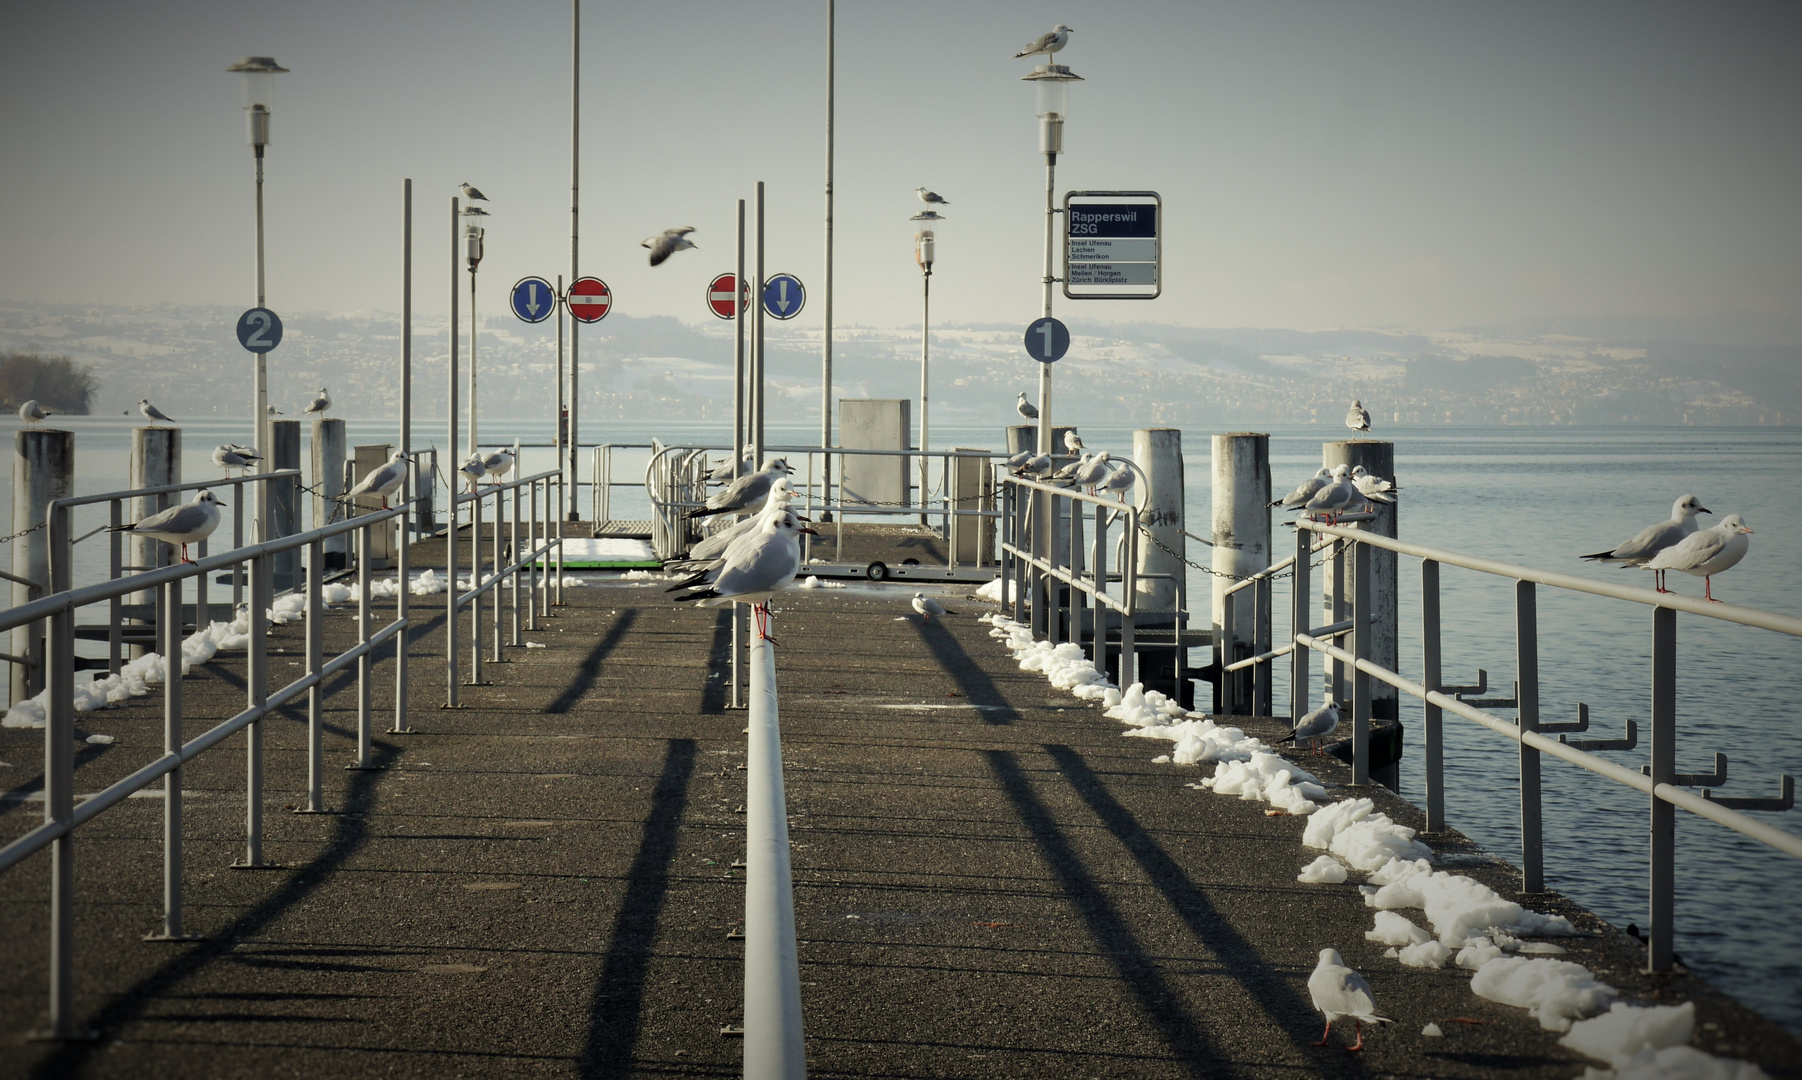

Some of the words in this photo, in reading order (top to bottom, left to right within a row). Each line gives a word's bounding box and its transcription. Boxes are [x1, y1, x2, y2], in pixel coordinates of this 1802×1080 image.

[1072, 212, 1136, 223] Rapperswil
[1072, 224, 1098, 234] ZSG
[246, 310, 273, 347] 2
[1035, 322, 1052, 357] 1
